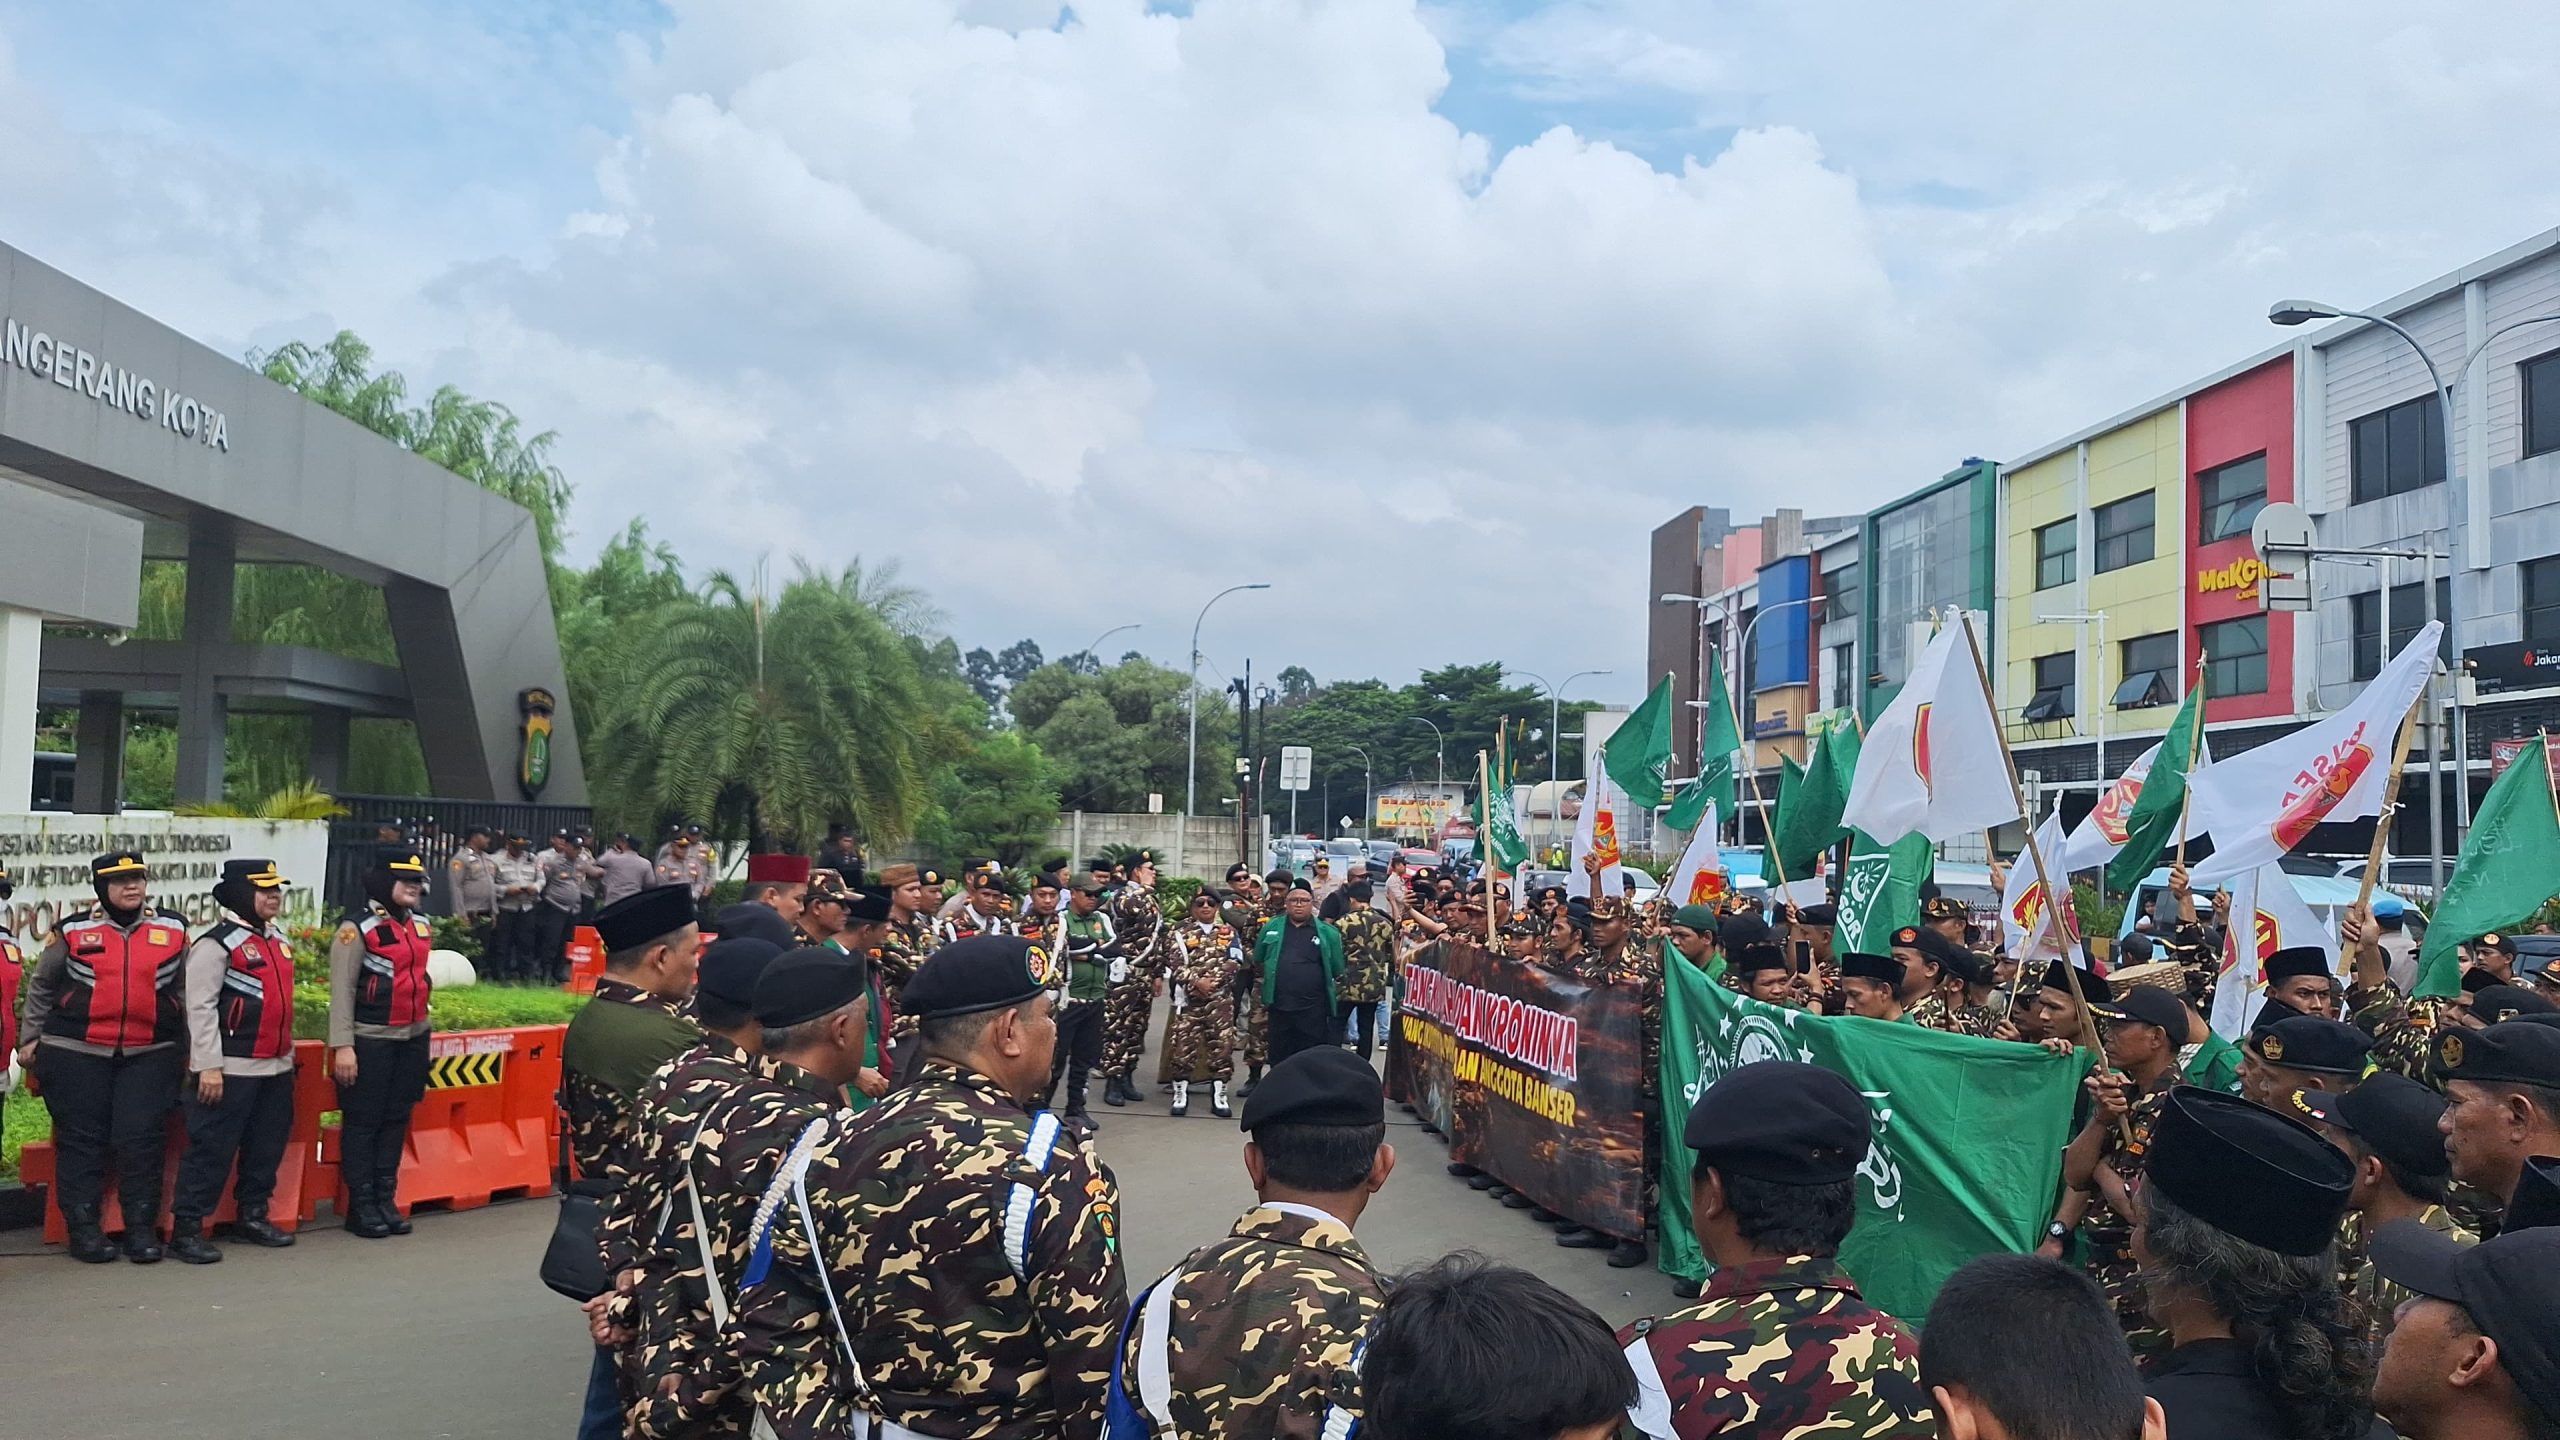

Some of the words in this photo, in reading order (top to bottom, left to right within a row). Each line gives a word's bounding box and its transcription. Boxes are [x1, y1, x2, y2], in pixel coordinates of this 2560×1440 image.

[162, 387, 229, 452] KOTA
[1484, 991, 1577, 1082] KRONINYA
[1479, 1054, 1523, 1107] ANGGOTA
[1524, 1076, 1576, 1128] BANSER
